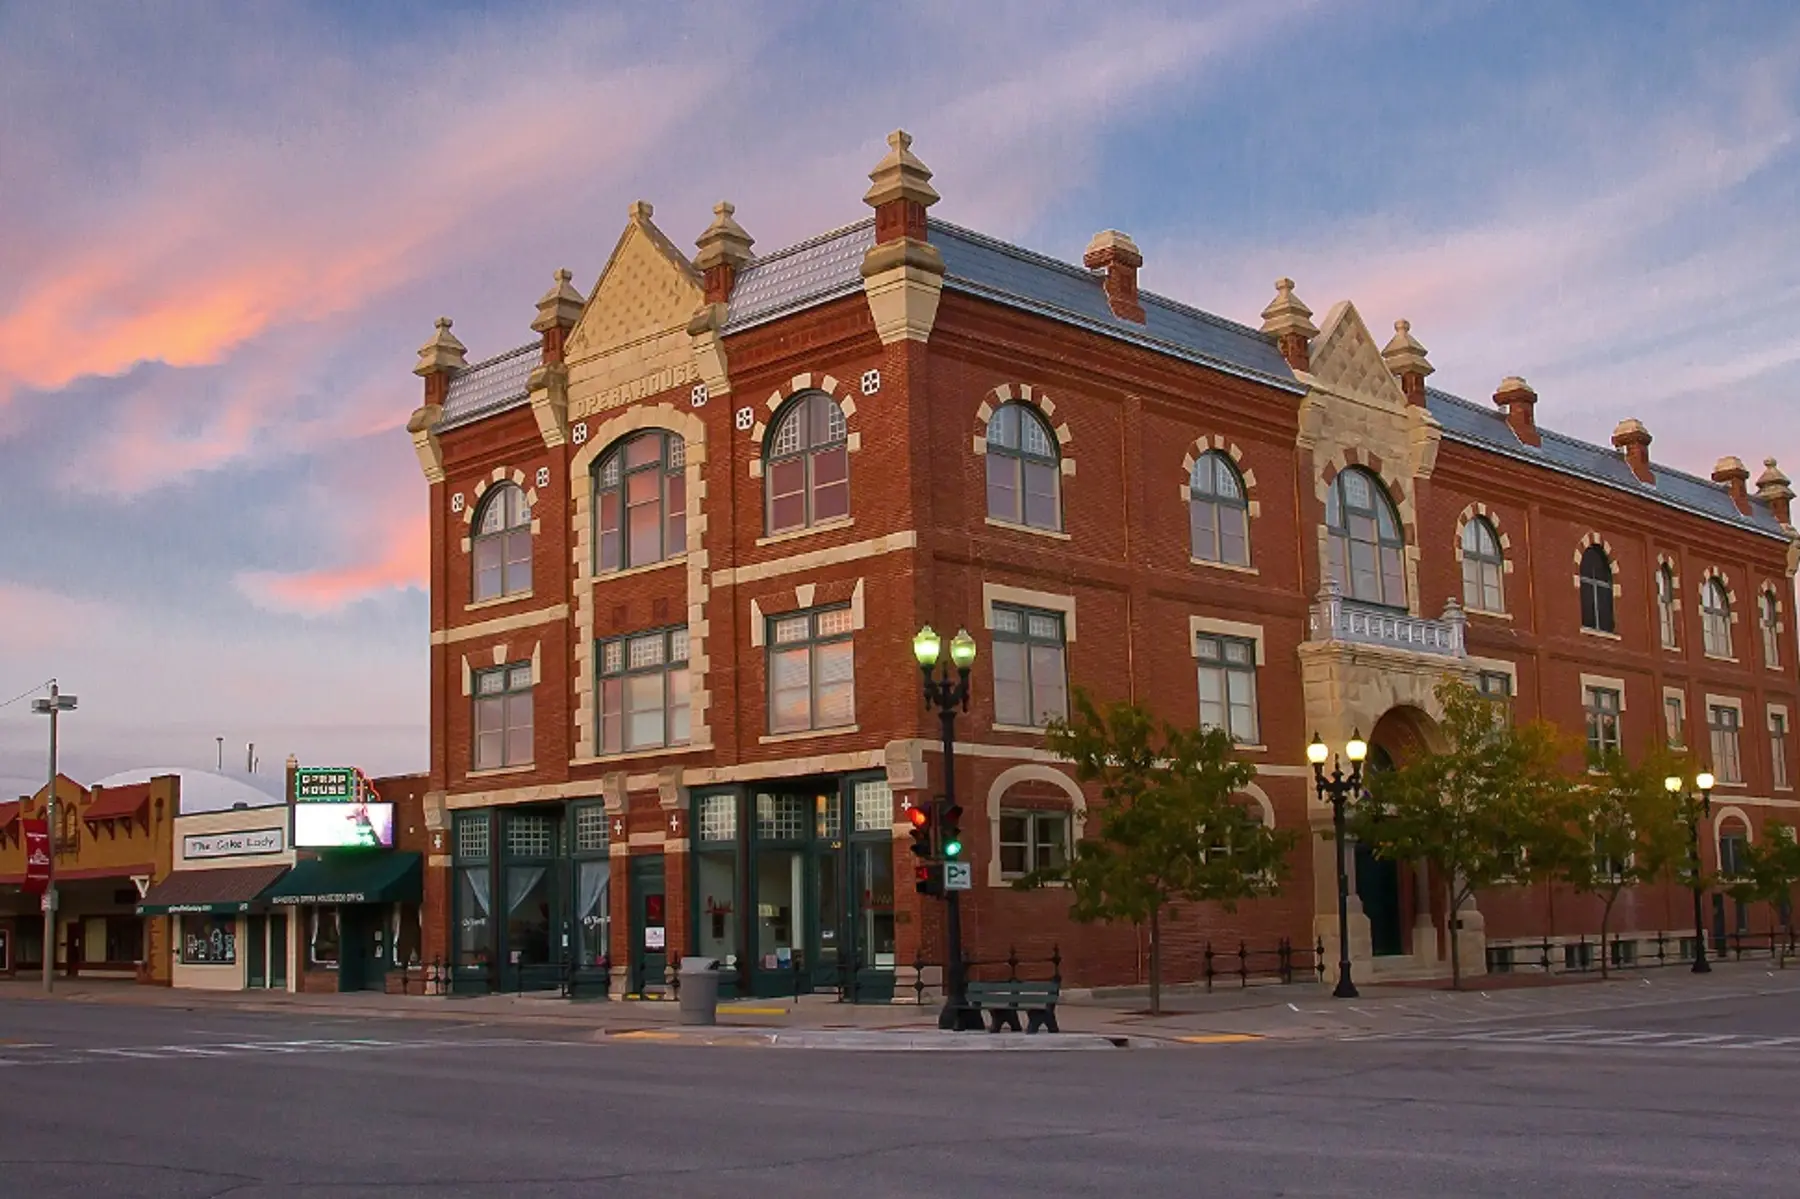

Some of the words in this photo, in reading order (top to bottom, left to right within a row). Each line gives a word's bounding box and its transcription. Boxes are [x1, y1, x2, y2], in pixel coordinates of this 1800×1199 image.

[577, 383, 631, 418] OPERA
[631, 361, 699, 400] HOUSE
[302, 786, 346, 795] HOUSE
[191, 841, 210, 852] The
[216, 839, 242, 850] Cake
[246, 836, 275, 847] Lady
